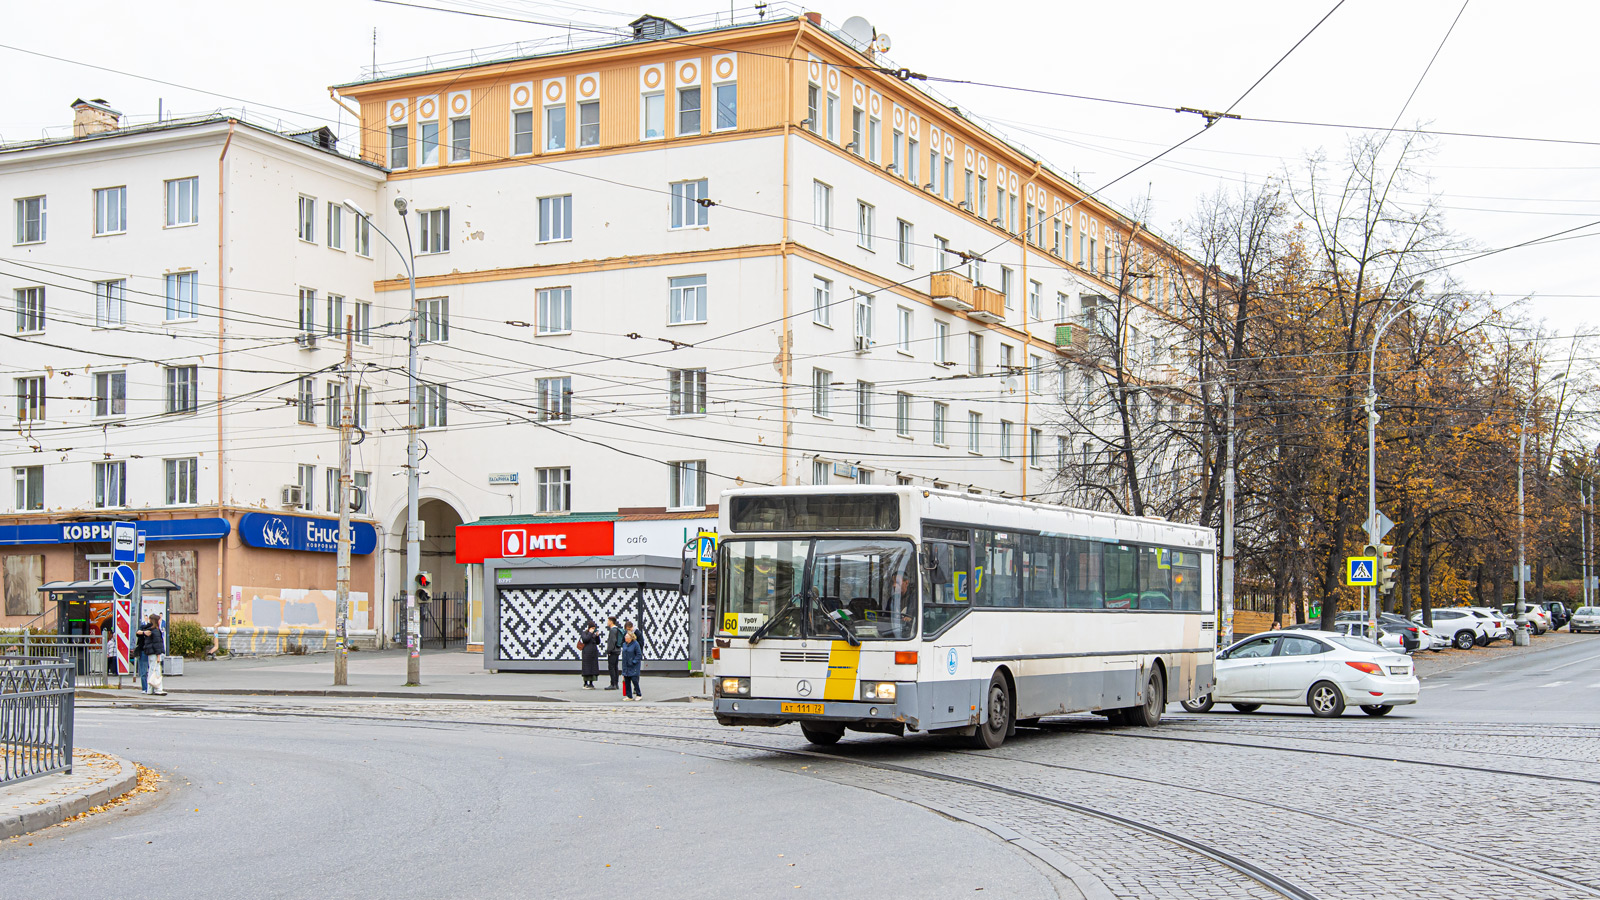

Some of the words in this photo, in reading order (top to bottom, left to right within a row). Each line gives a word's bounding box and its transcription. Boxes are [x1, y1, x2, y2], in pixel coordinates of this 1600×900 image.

[63, 525, 112, 540] КОВРЫ
[529, 534, 567, 551] МТС
[626, 535, 648, 544] cafe
[596, 567, 640, 579] ПРЕССА
[724, 618, 738, 630] 60
[797, 704, 811, 713] 111
